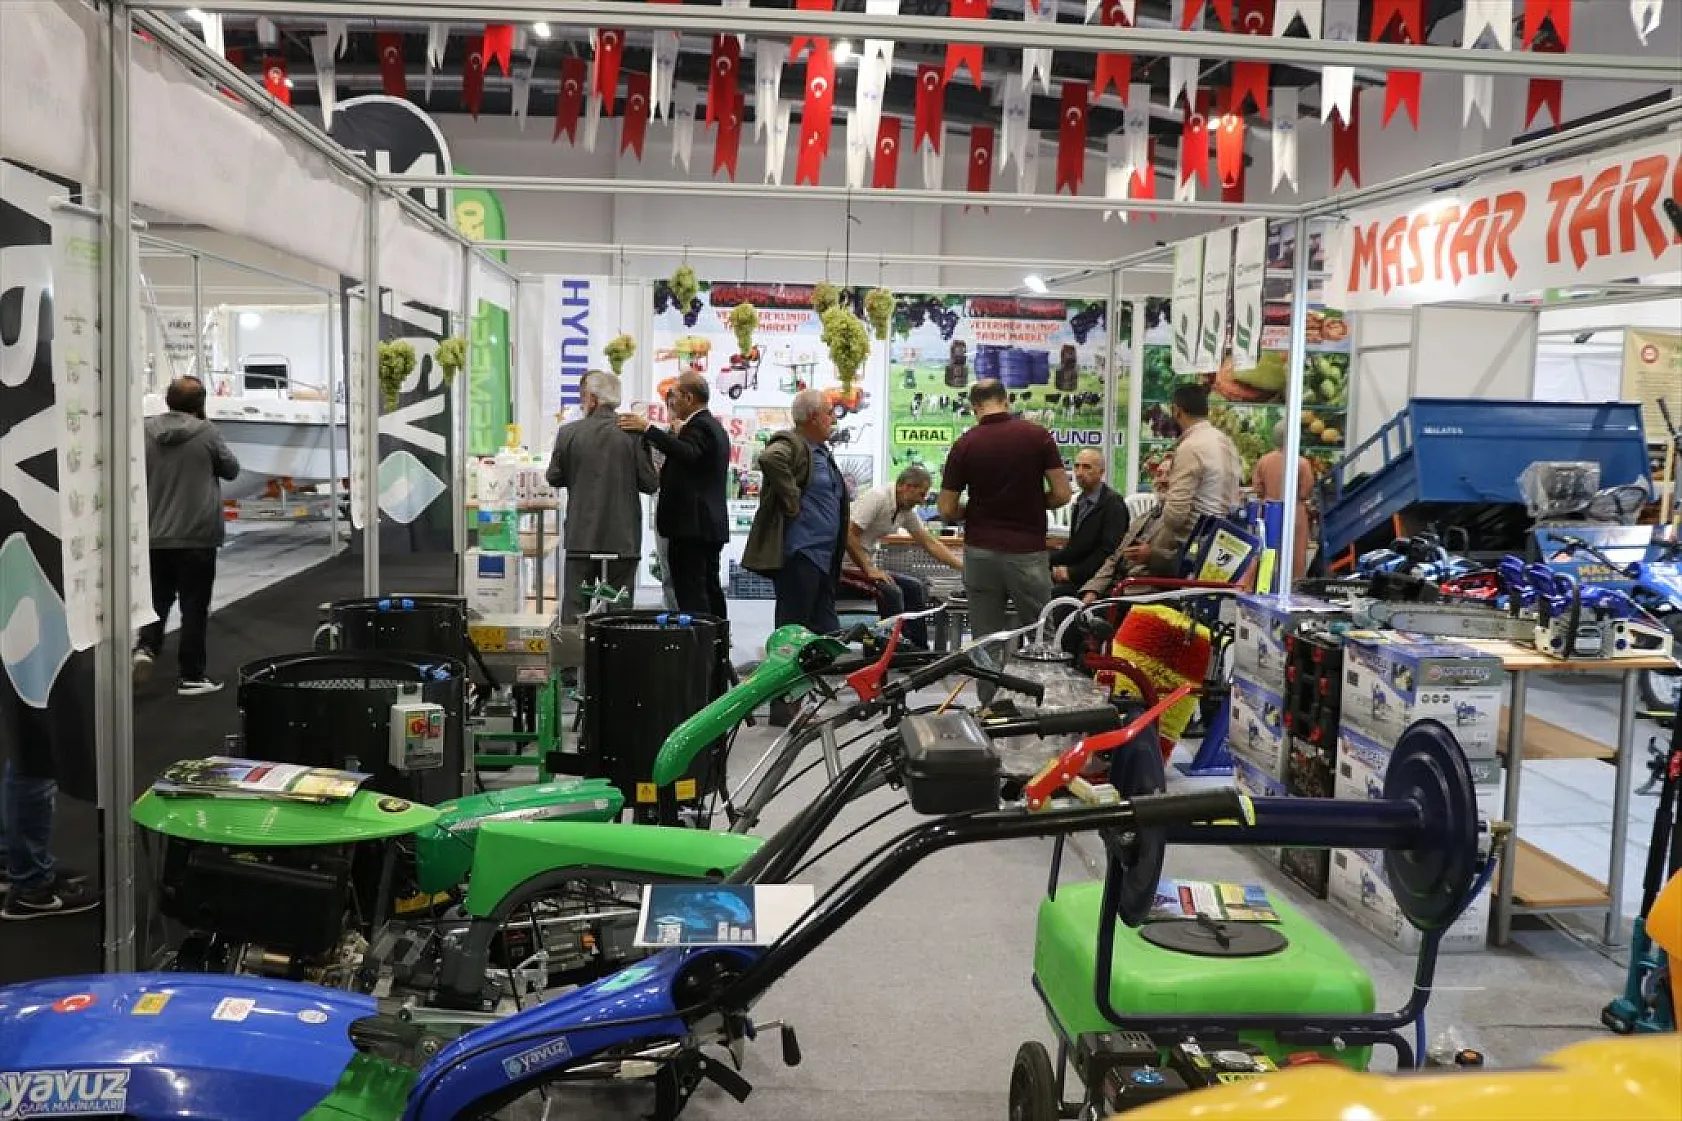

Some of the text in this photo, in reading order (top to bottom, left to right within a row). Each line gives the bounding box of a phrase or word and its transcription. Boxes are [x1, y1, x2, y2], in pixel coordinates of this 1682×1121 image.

[1347, 190, 1526, 296] MASTAR
[900, 429, 949, 441] TARAL
[2, 1072, 126, 1116] yavuz
